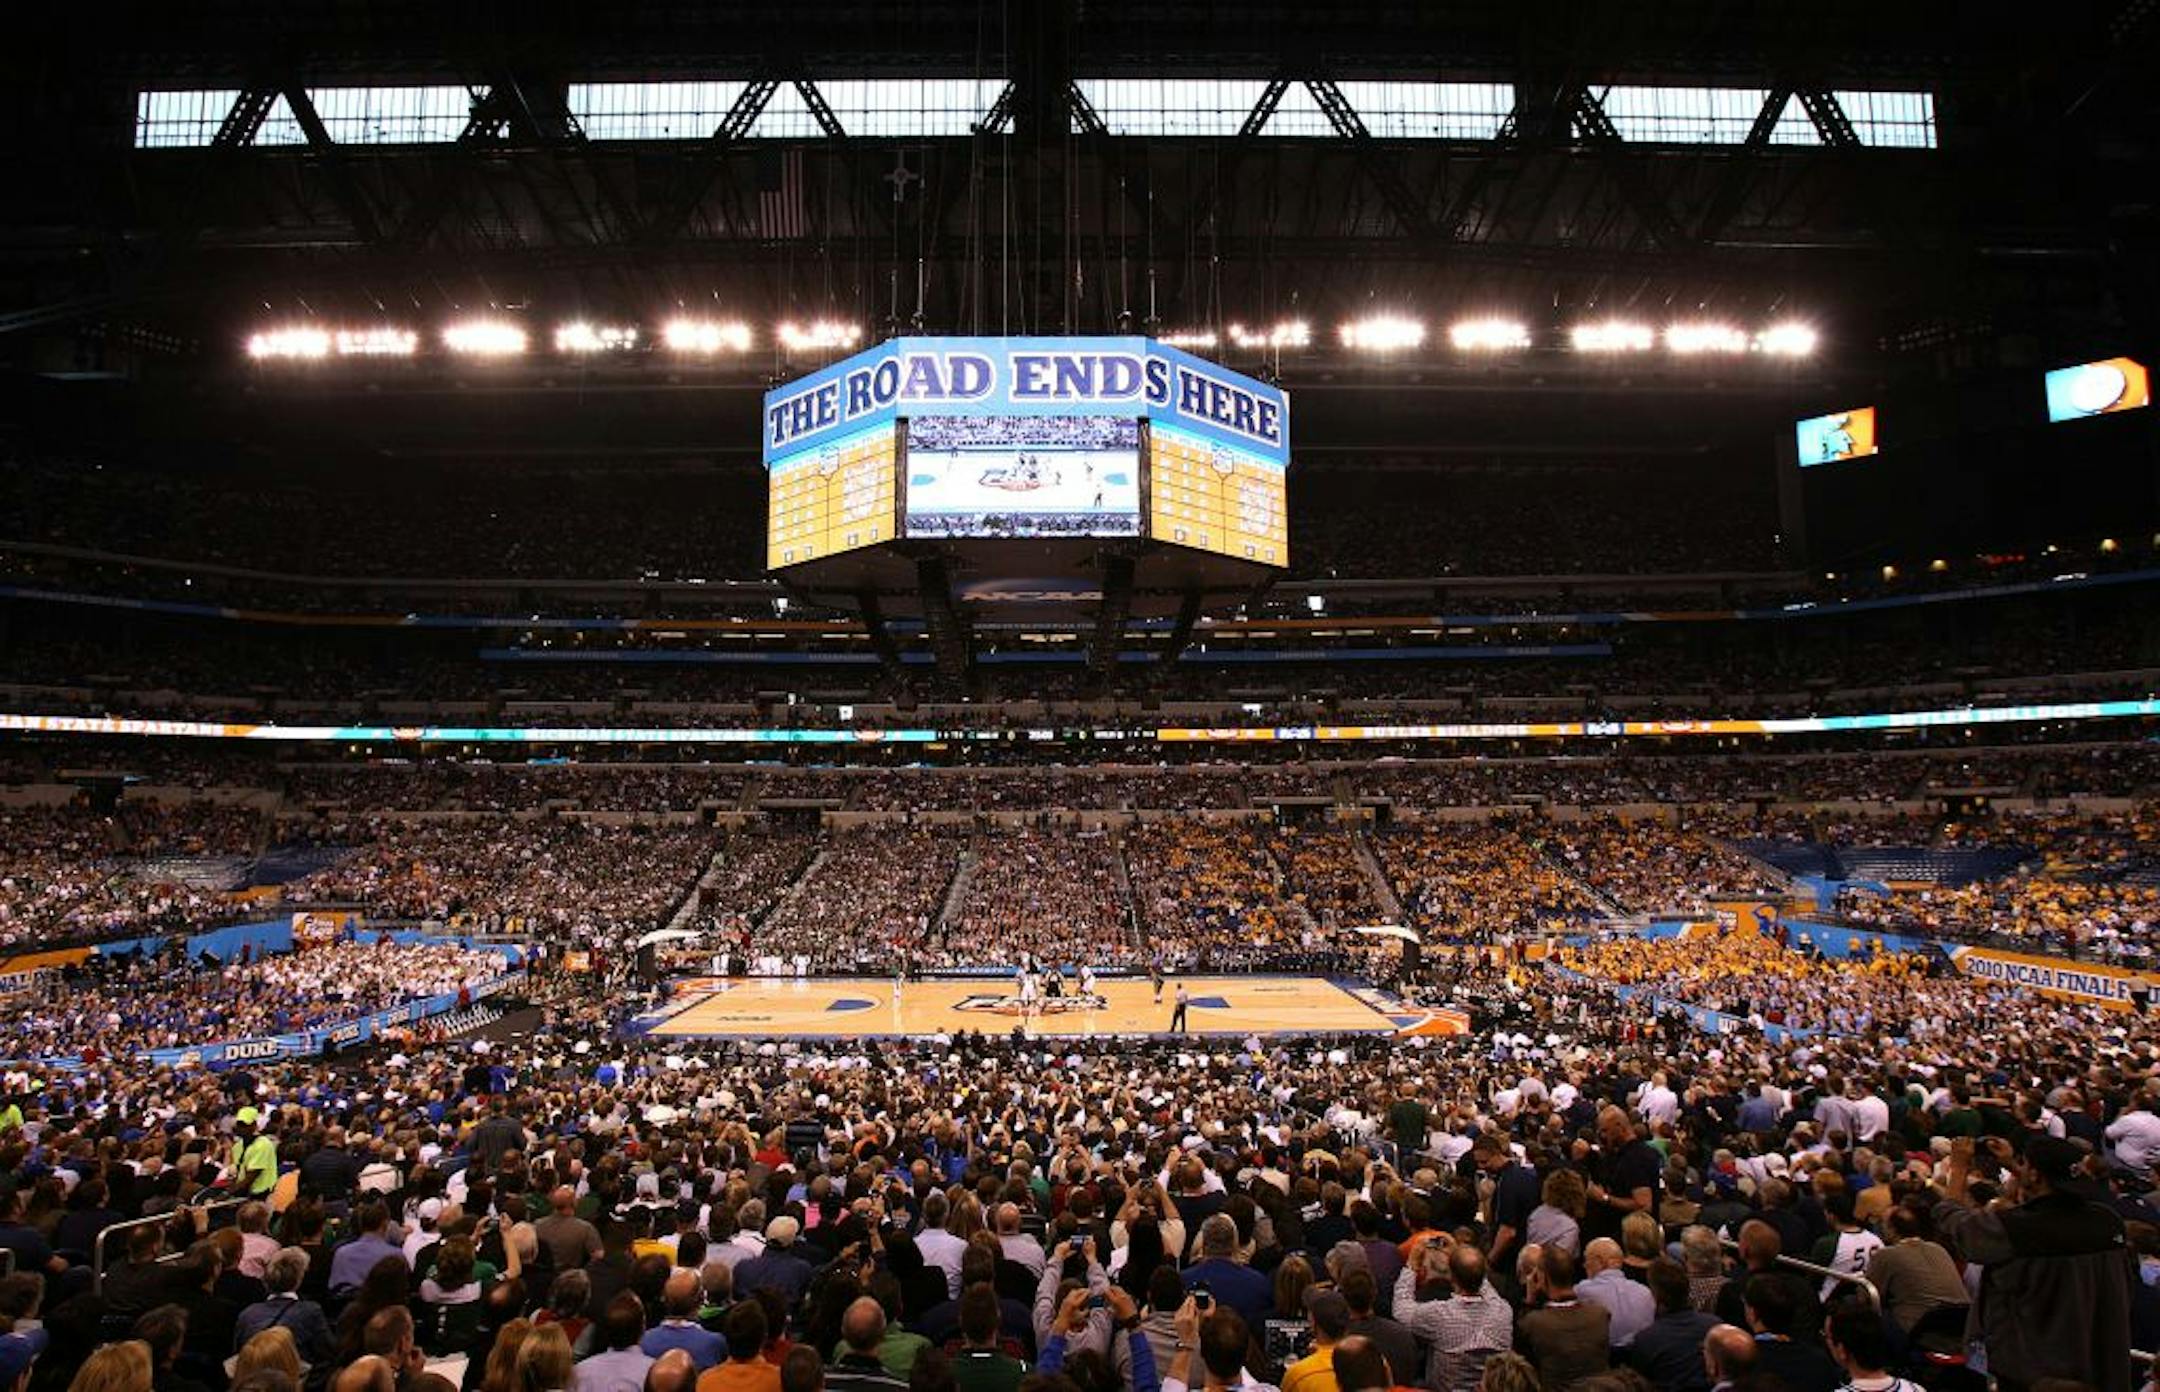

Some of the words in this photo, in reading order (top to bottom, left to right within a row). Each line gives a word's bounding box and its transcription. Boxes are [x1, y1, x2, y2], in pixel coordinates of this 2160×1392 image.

[768, 381, 838, 445] THE
[847, 355, 993, 416] ROAD
[1013, 355, 1168, 404] ENDS
[1179, 369, 1280, 443] HERE
[1967, 957, 2001, 977] 2010
[2004, 964, 2051, 986] NCAA
[2056, 972, 2114, 998] FINAL
[224, 1041, 278, 1061] DUKE
